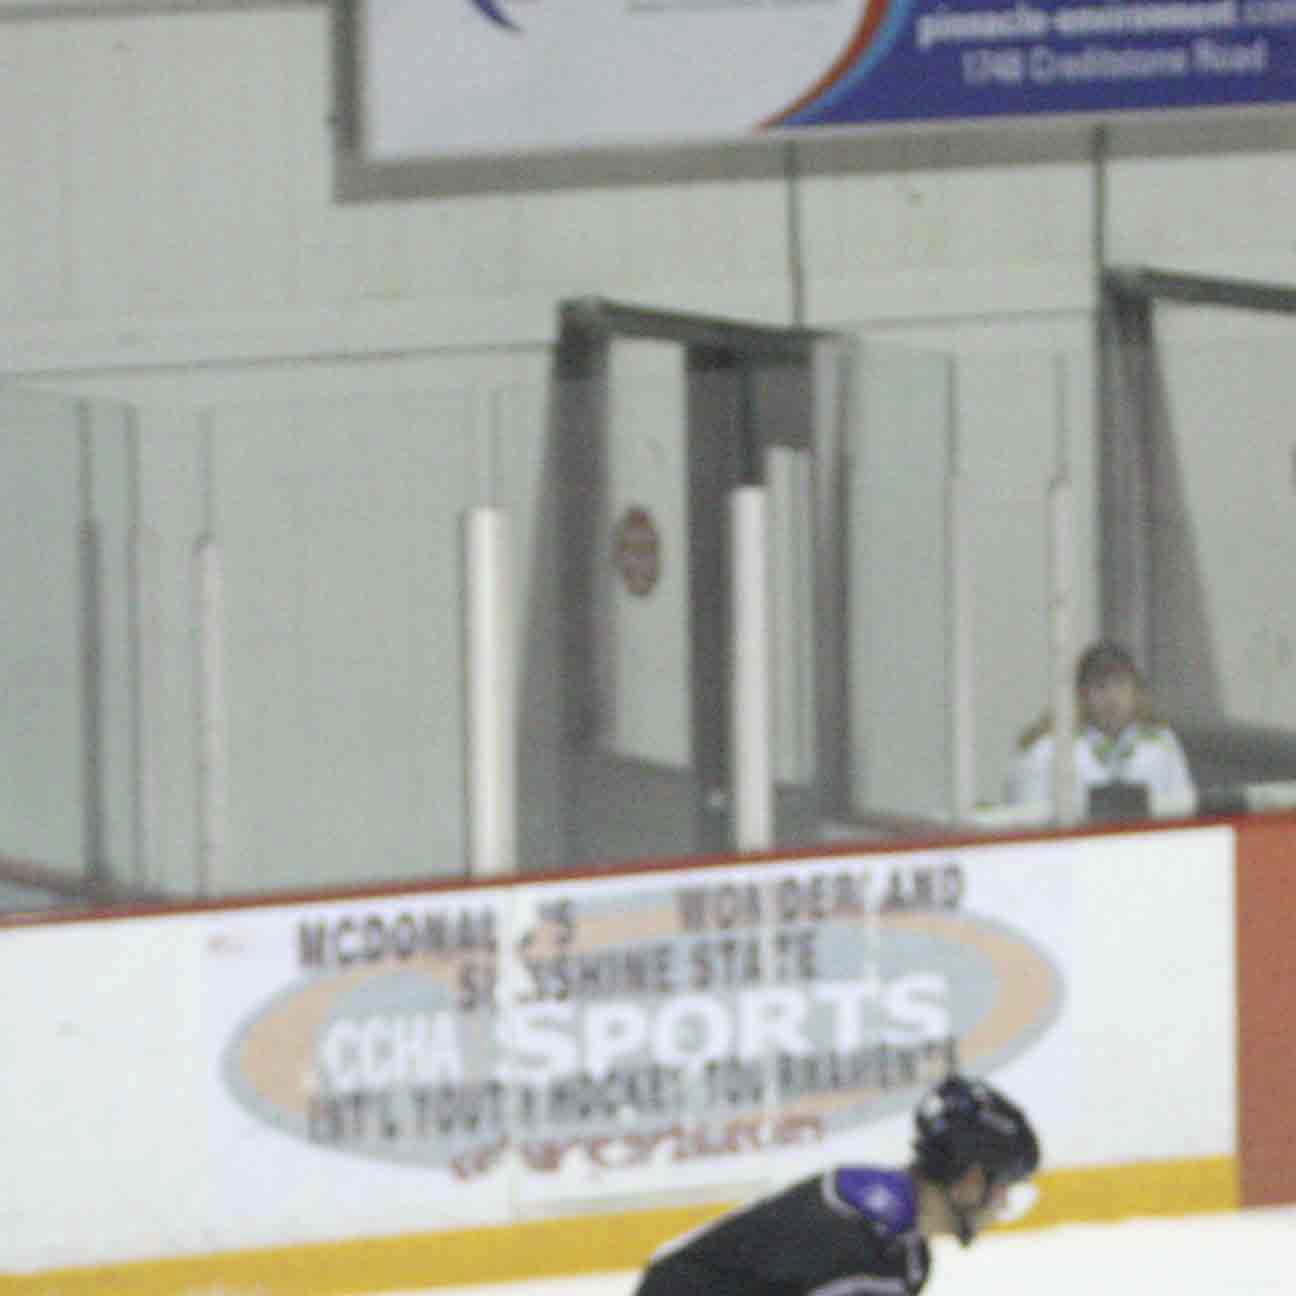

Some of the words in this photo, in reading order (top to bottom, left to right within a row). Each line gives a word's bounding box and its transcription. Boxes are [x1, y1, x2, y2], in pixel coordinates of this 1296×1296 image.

[297, 896, 576, 969] MCDONAL'S
[690, 928, 818, 989] STATE
[496, 970, 952, 1086] SPORTS
